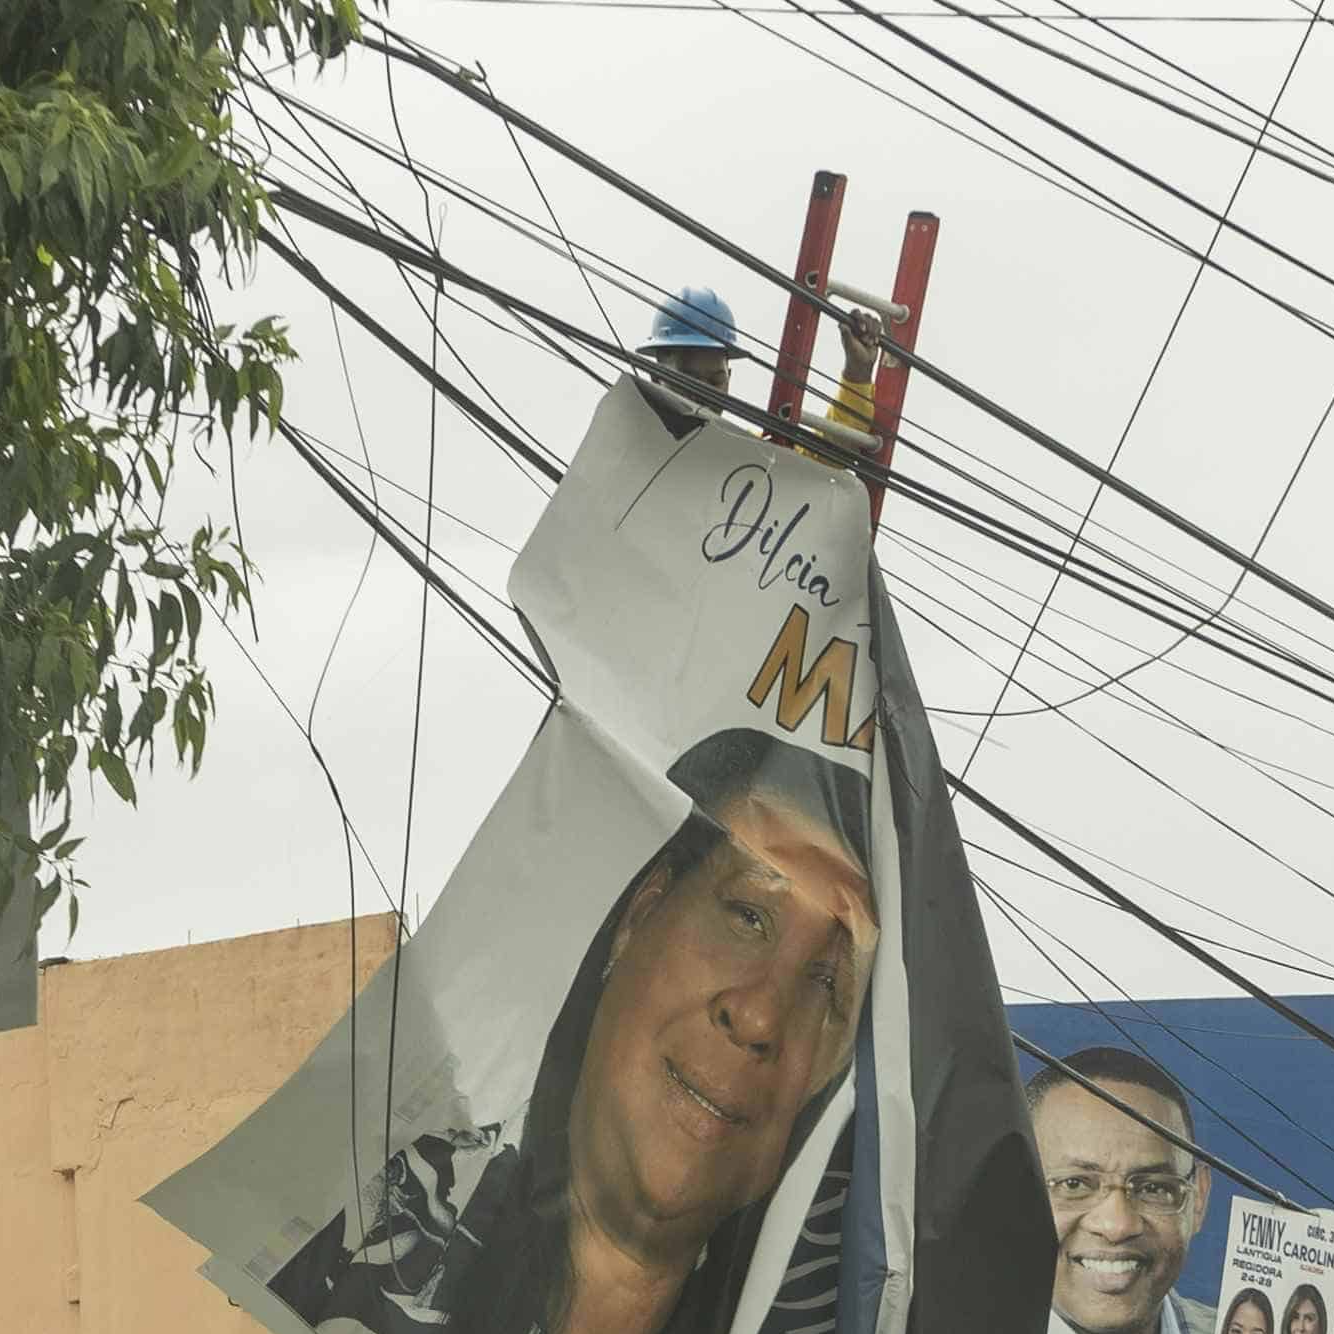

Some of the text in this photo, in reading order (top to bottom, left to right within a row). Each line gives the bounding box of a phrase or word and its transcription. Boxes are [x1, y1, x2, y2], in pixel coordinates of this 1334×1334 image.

[701, 463, 840, 607] Dilcia
[1243, 1212, 1286, 1251] YENNY
[1232, 1258, 1283, 1279] REGIDORA
[1236, 1246, 1282, 1264] LANTIGUA
